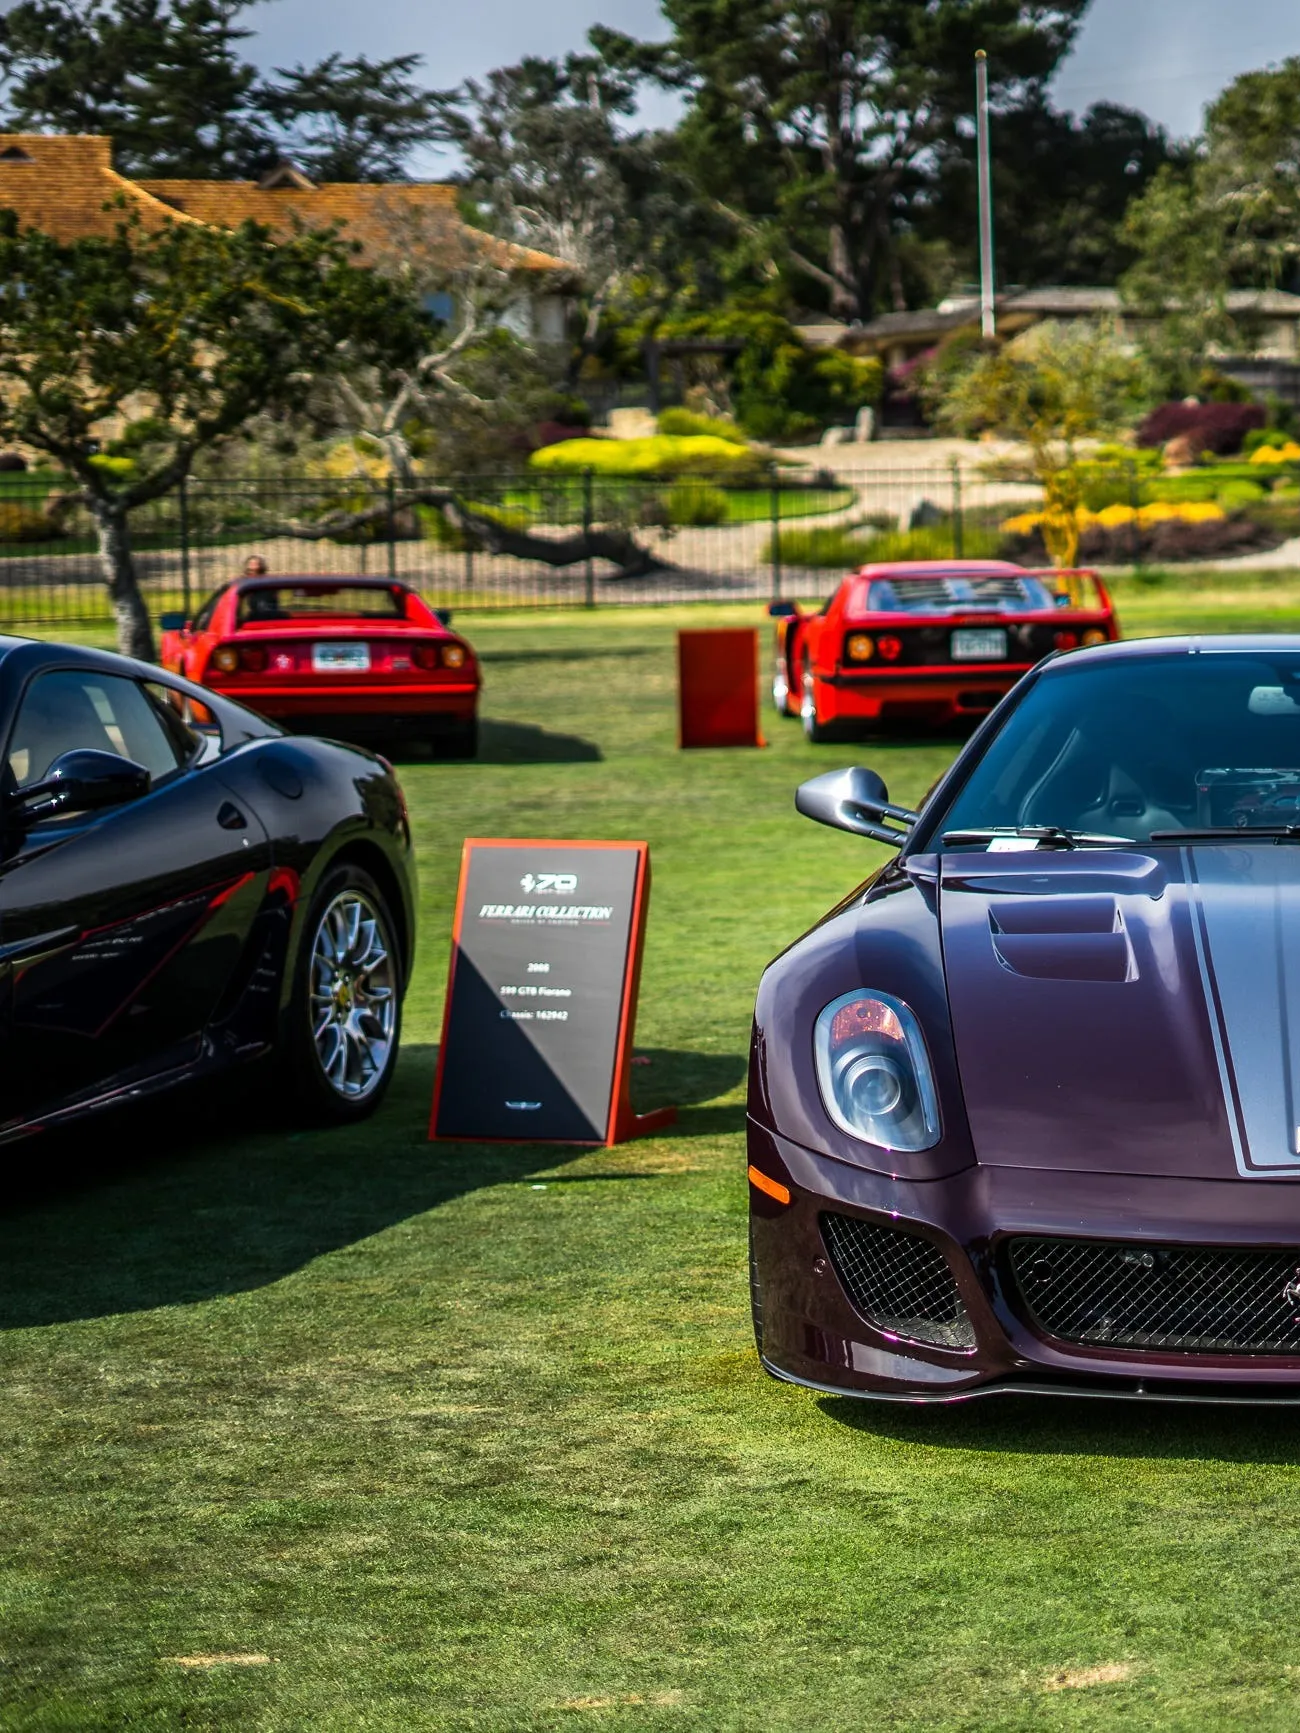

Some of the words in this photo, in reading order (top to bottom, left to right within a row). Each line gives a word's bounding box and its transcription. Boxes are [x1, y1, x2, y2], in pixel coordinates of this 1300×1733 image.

[535, 873, 578, 890] 70
[479, 904, 537, 919] FERRARI
[535, 905, 614, 920] COLLECTION
[500, 985, 517, 996] 599
[517, 985, 538, 997] GTB
